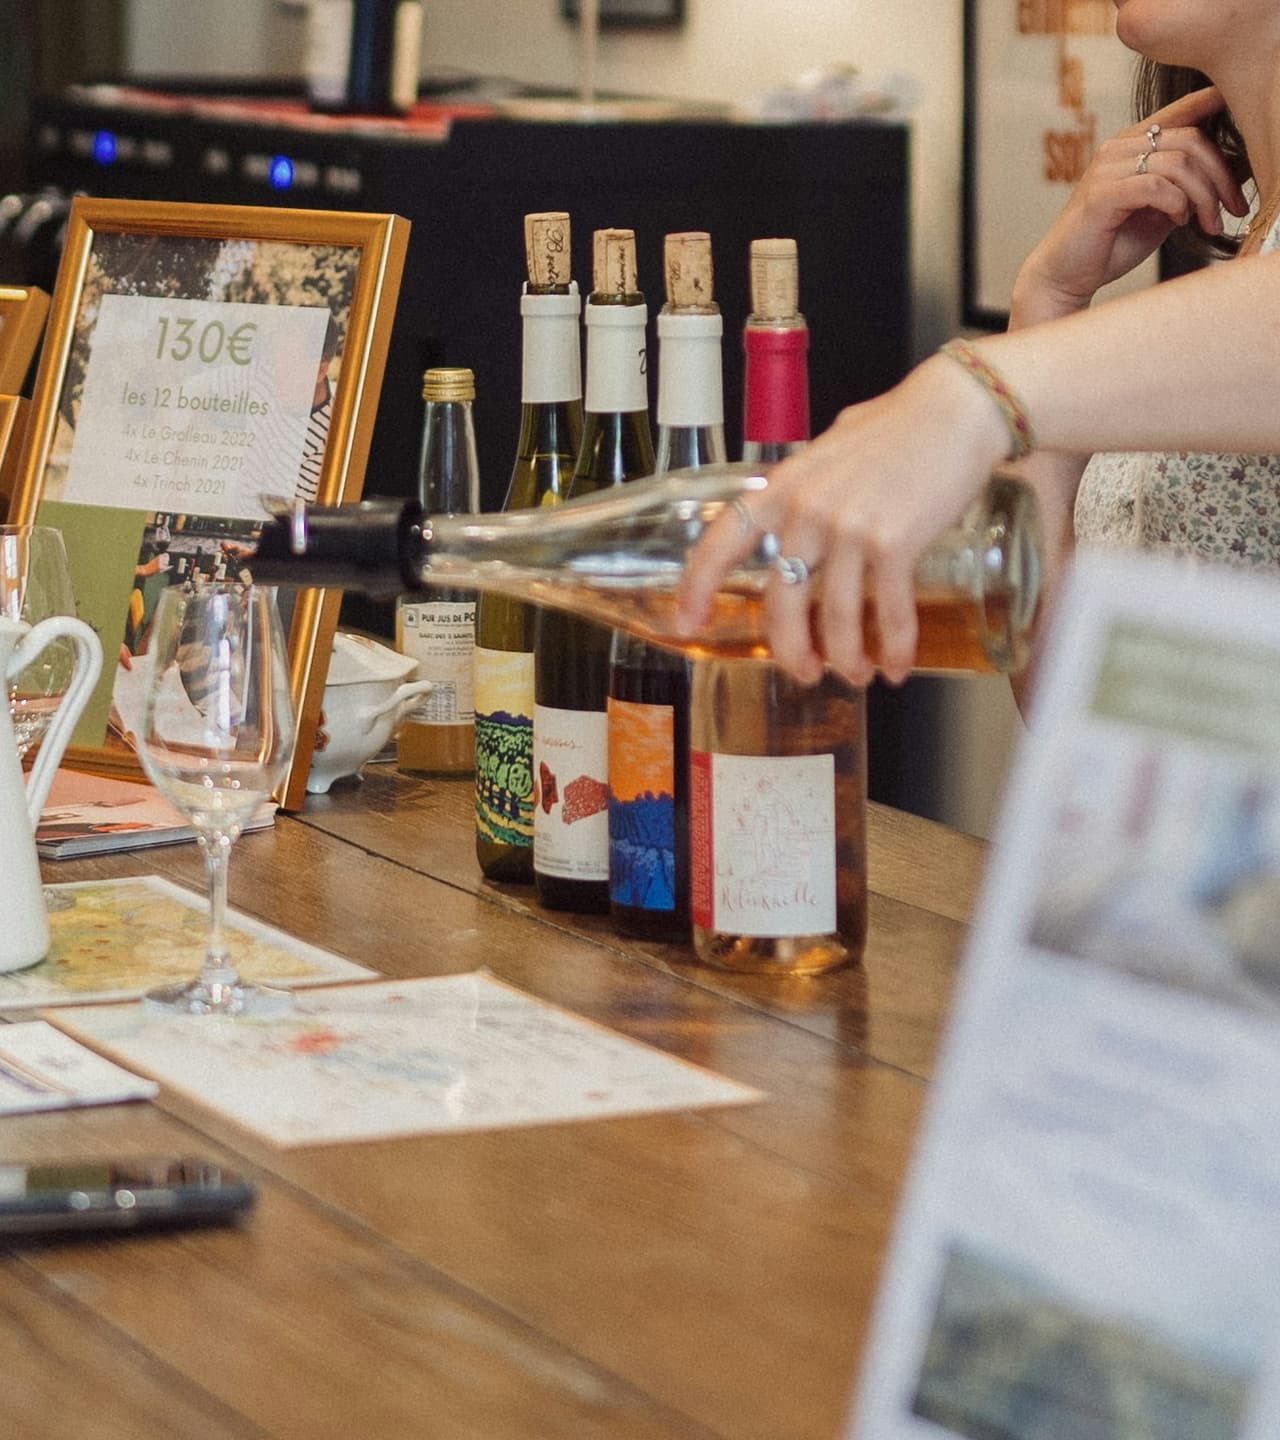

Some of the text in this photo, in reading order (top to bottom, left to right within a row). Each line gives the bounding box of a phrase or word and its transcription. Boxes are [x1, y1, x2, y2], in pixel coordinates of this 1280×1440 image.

[156, 316, 257, 366] 130€
[121, 382, 269, 416] les 12 bouteilles
[120, 423, 138, 437] 4x
[160, 425, 217, 445] Grolleau
[221, 431, 256, 448] 2022
[163, 450, 208, 467] Chenin
